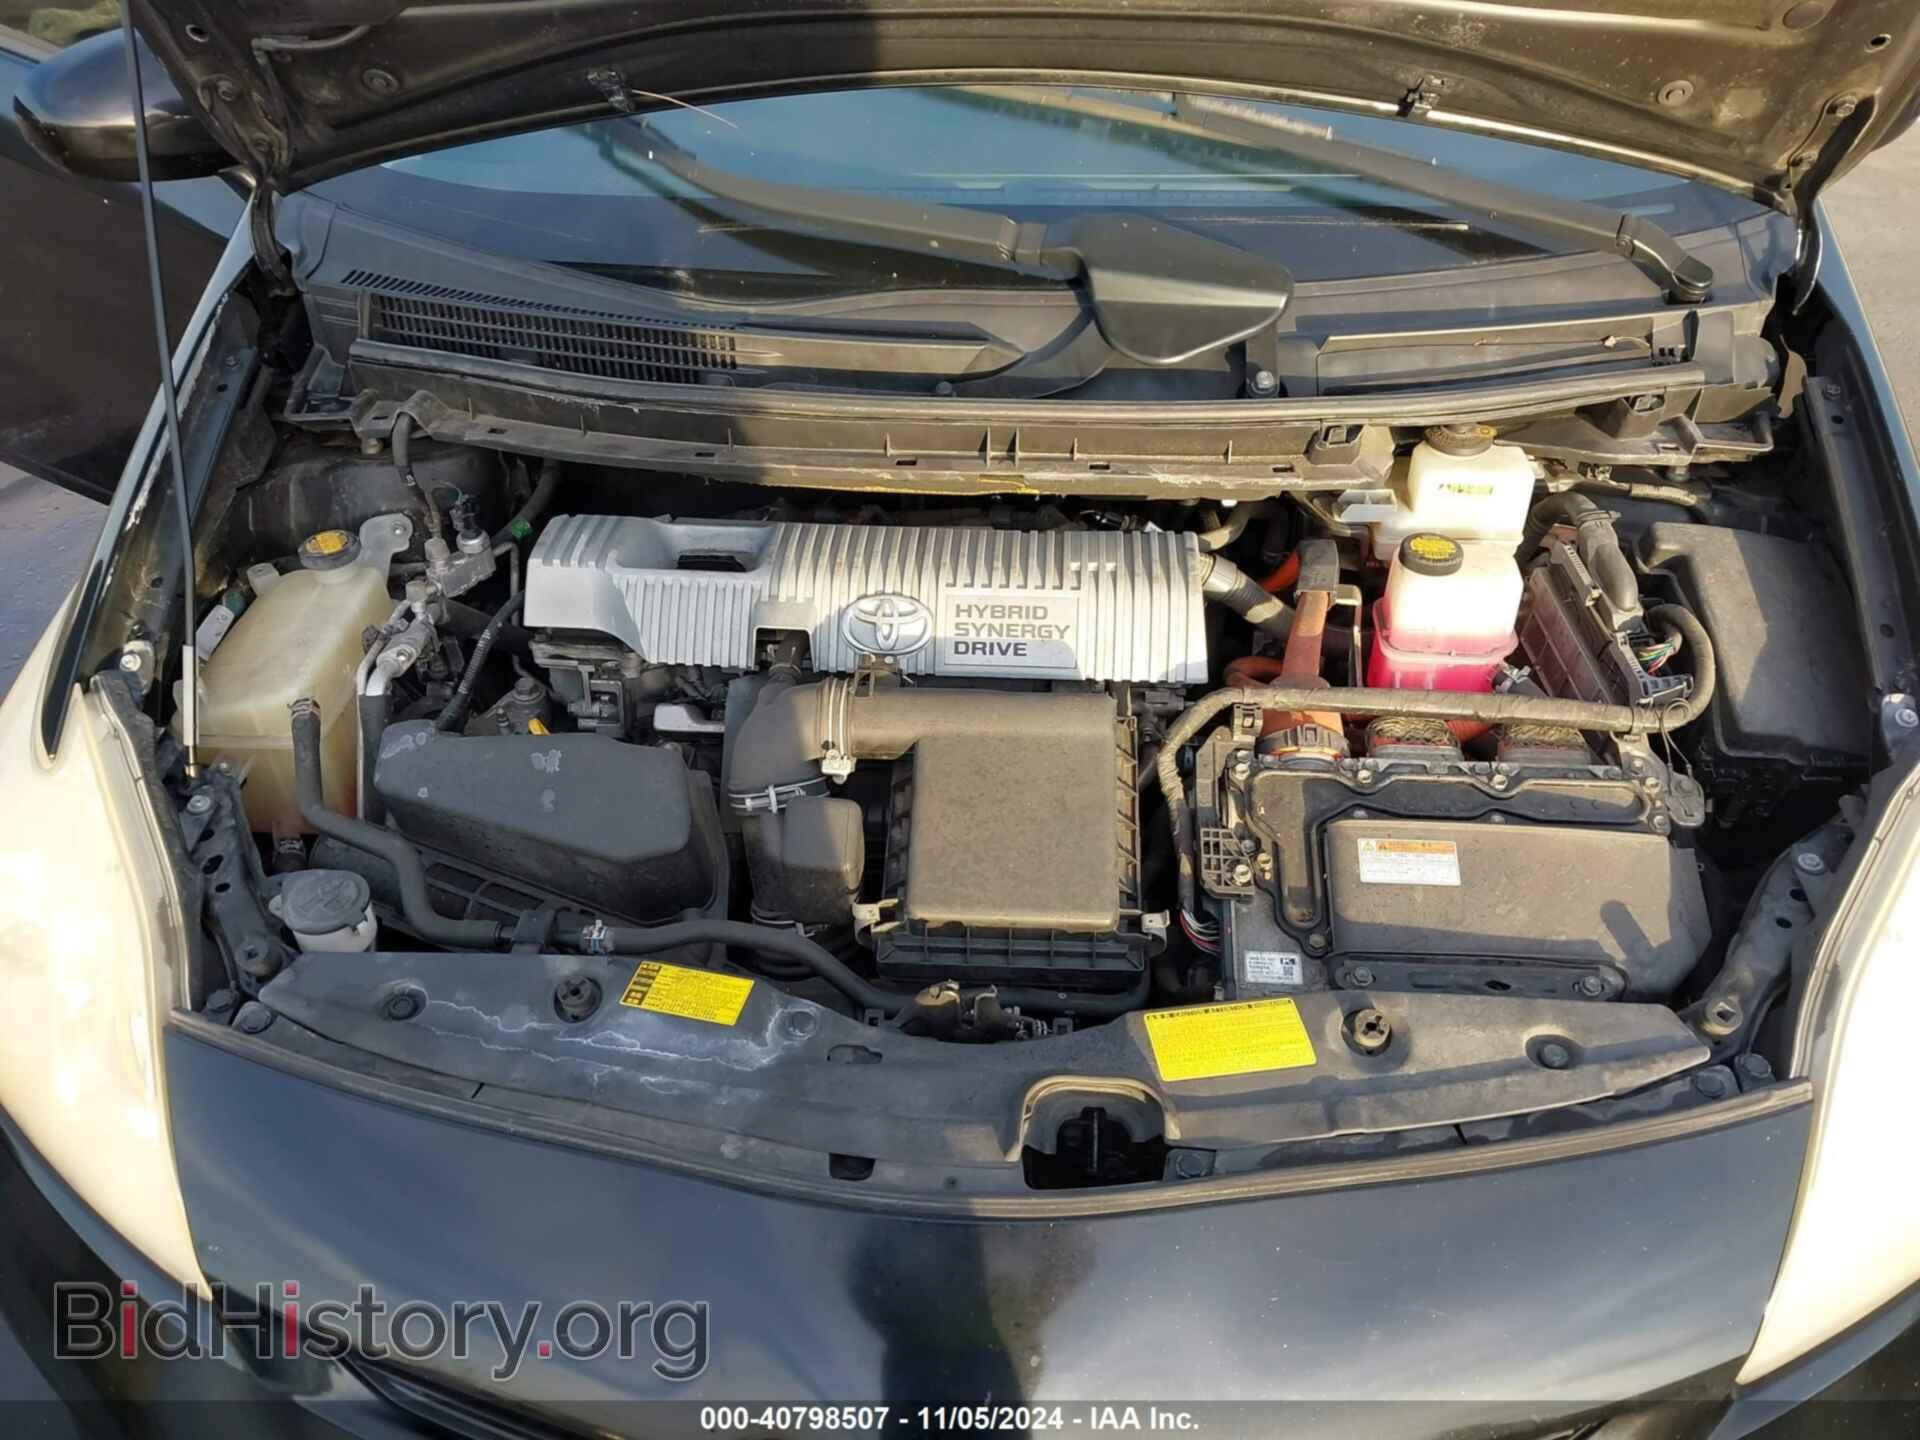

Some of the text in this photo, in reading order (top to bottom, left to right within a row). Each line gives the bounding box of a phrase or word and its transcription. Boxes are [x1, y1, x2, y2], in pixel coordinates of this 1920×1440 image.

[955, 603, 1049, 620] HYBRID
[954, 621, 1071, 640] SYNERGY
[953, 640, 1028, 657] DRIVE
